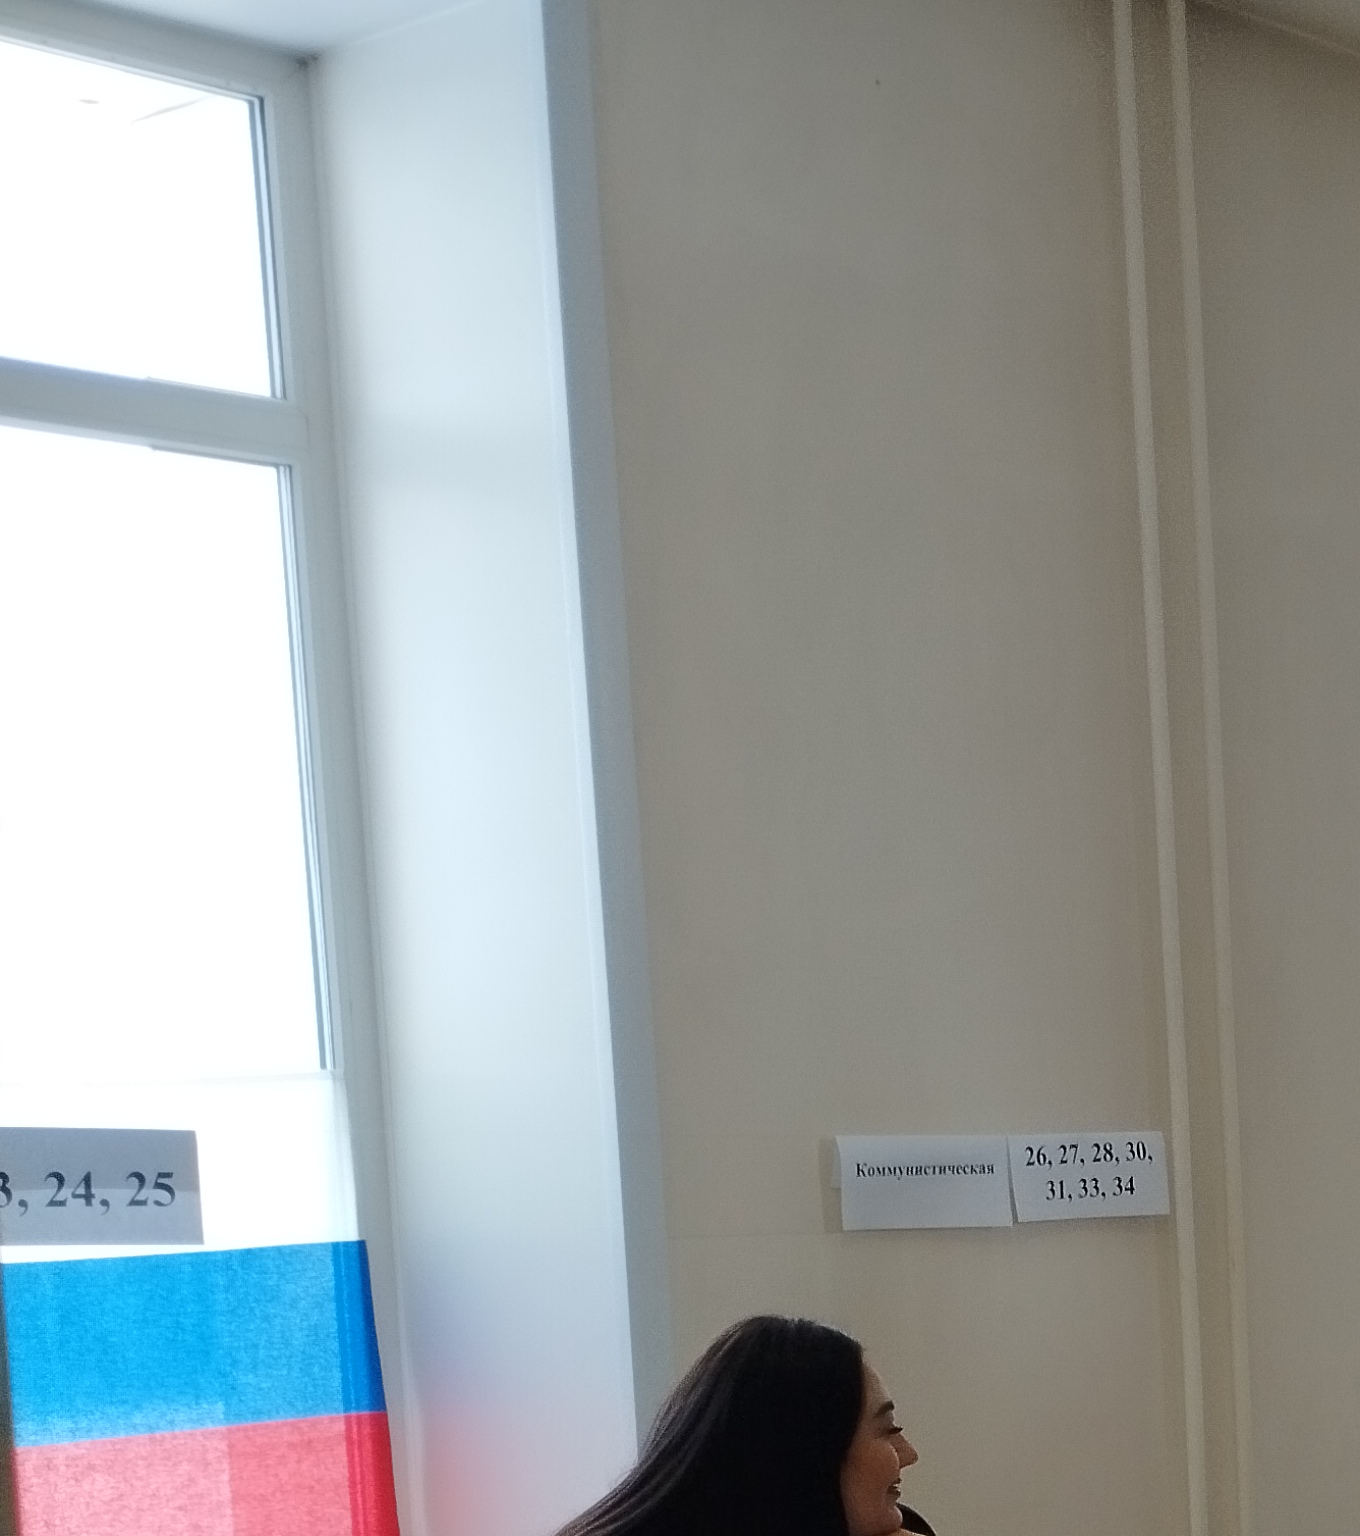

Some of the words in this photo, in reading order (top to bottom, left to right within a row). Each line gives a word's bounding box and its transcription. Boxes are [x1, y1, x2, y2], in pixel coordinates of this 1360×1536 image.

[1025, 1145, 1053, 1168] 26,
[1058, 1144, 1085, 1166] 27,
[1092, 1142, 1120, 1165] 28,
[1126, 1141, 1153, 1163] 30,
[855, 1163, 996, 1181] Коммунистическая
[44, 1171, 111, 1217] 24,
[125, 1171, 176, 1207] 25
[1046, 1180, 1073, 1202] 31,
[1078, 1178, 1106, 1200] 33,
[1112, 1175, 1136, 1197] 34
